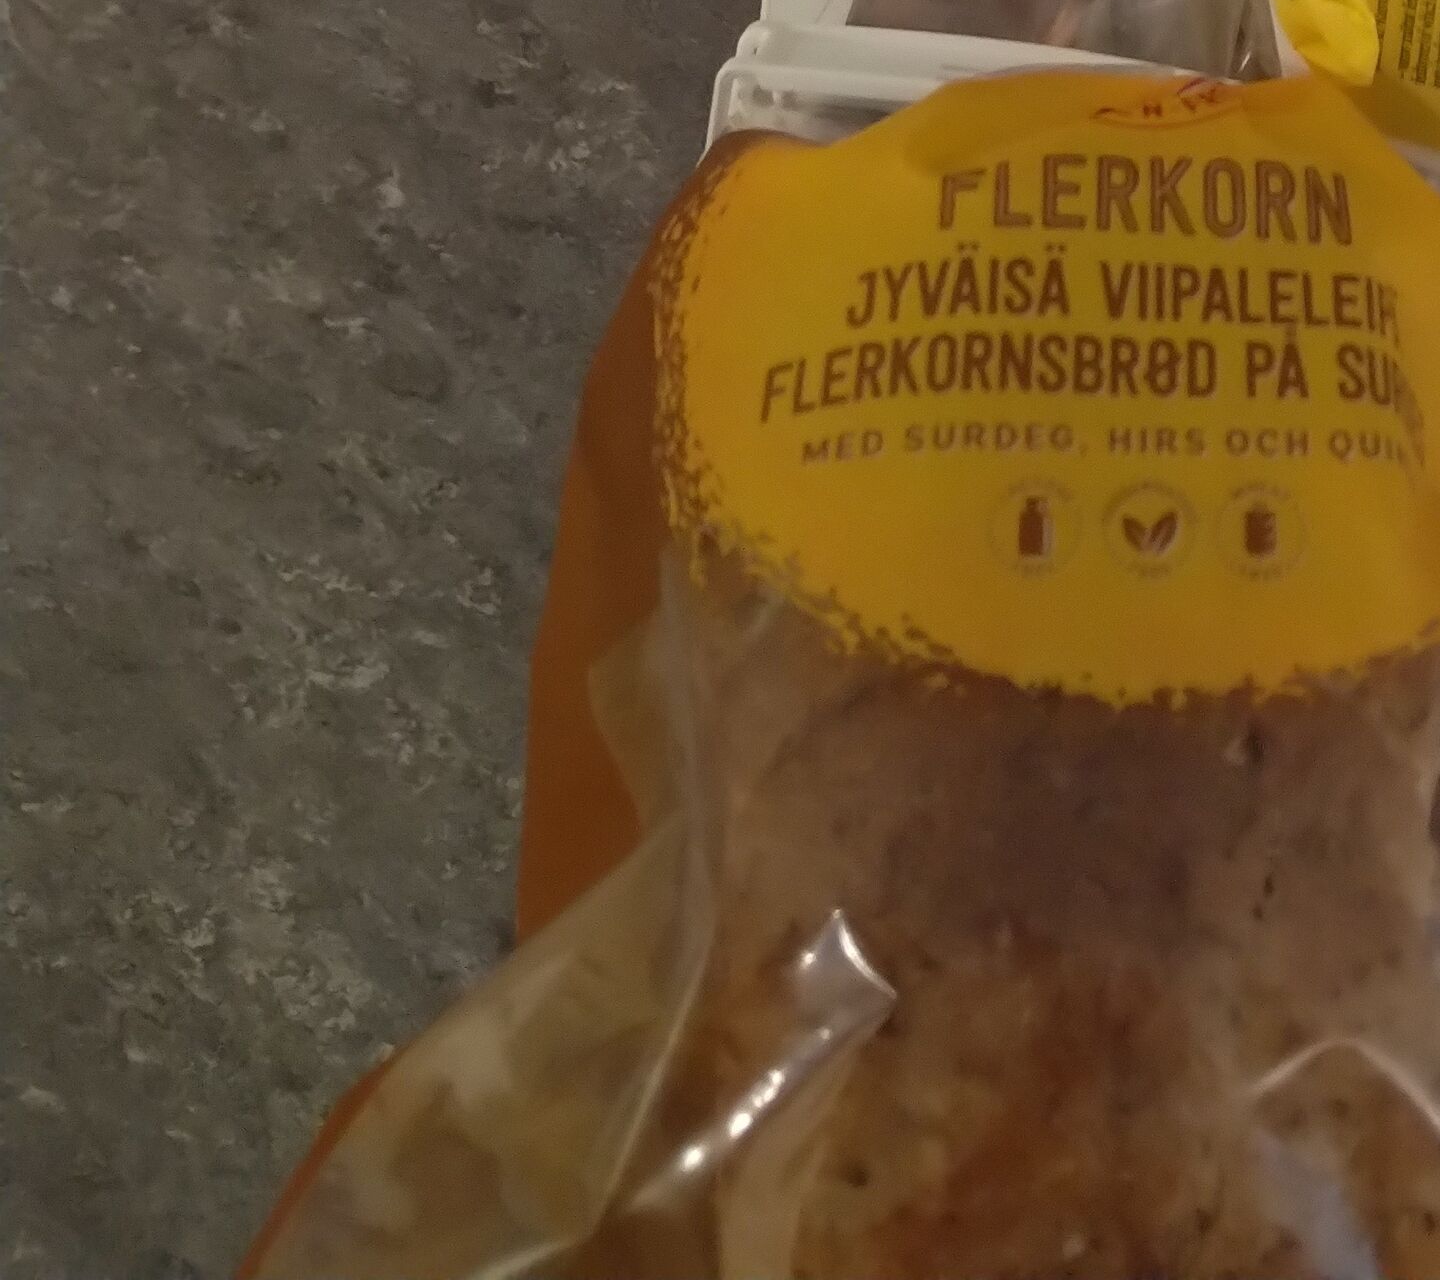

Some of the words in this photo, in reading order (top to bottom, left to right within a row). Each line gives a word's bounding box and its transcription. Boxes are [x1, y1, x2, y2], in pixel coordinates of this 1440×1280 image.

[938, 155, 1353, 247] FLERKORN
[845, 245, 1071, 329] JYVÄISÄ
[759, 334, 1219, 425] FLERKORNSBRØD
[1246, 322, 1309, 400] PÅ
[802, 431, 885, 466] MED
[904, 421, 1088, 458] SURDEG,
[1108, 425, 1206, 458] HIRS
[1225, 426, 1312, 458] OCH
